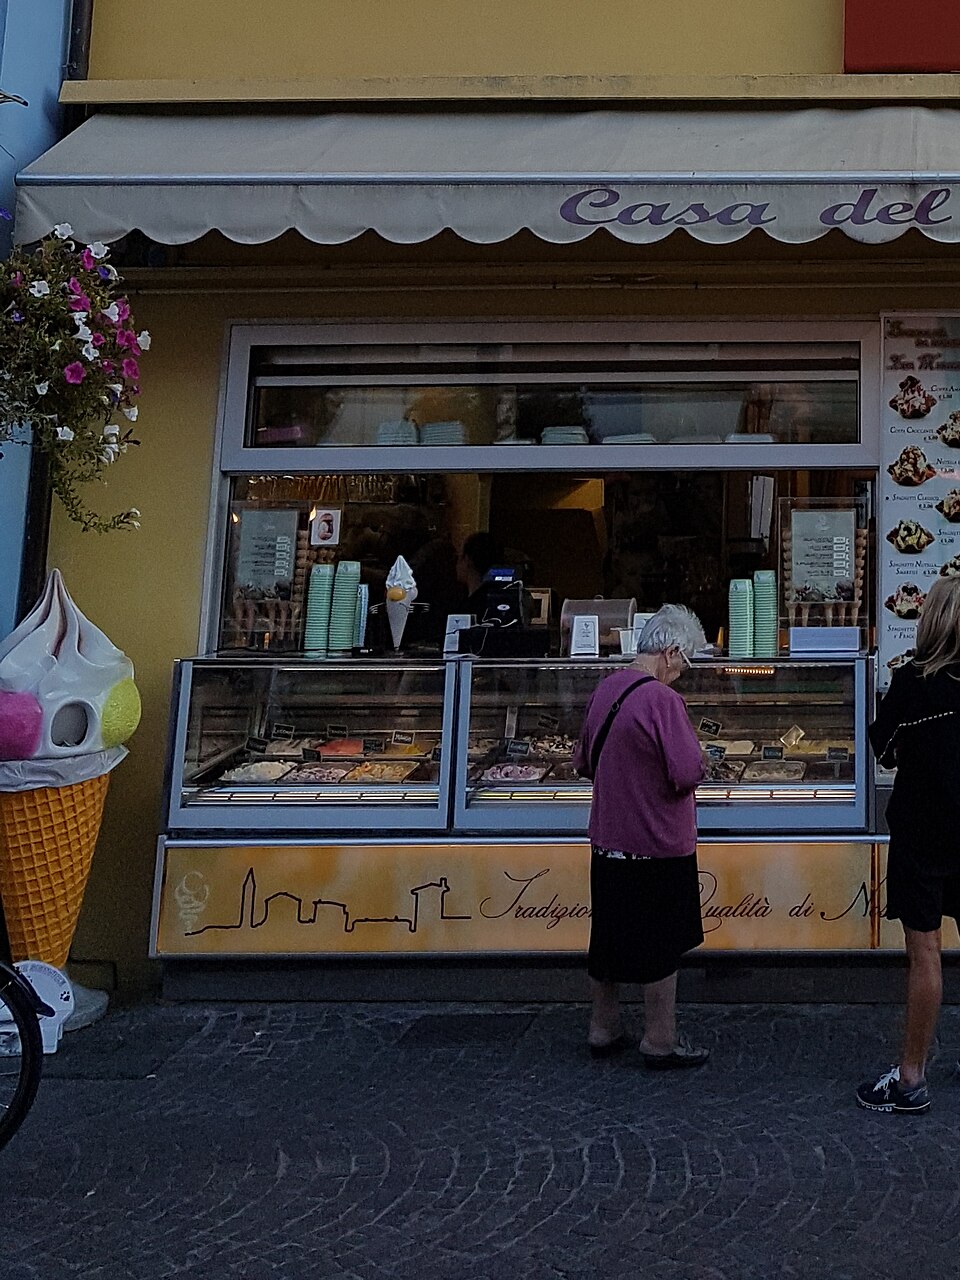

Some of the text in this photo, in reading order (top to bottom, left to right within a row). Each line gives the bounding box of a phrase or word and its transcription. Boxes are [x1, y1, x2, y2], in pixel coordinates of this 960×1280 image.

[560, 188, 777, 226] Casa
[819, 188, 952, 226] del
[788, 893, 815, 918] di
